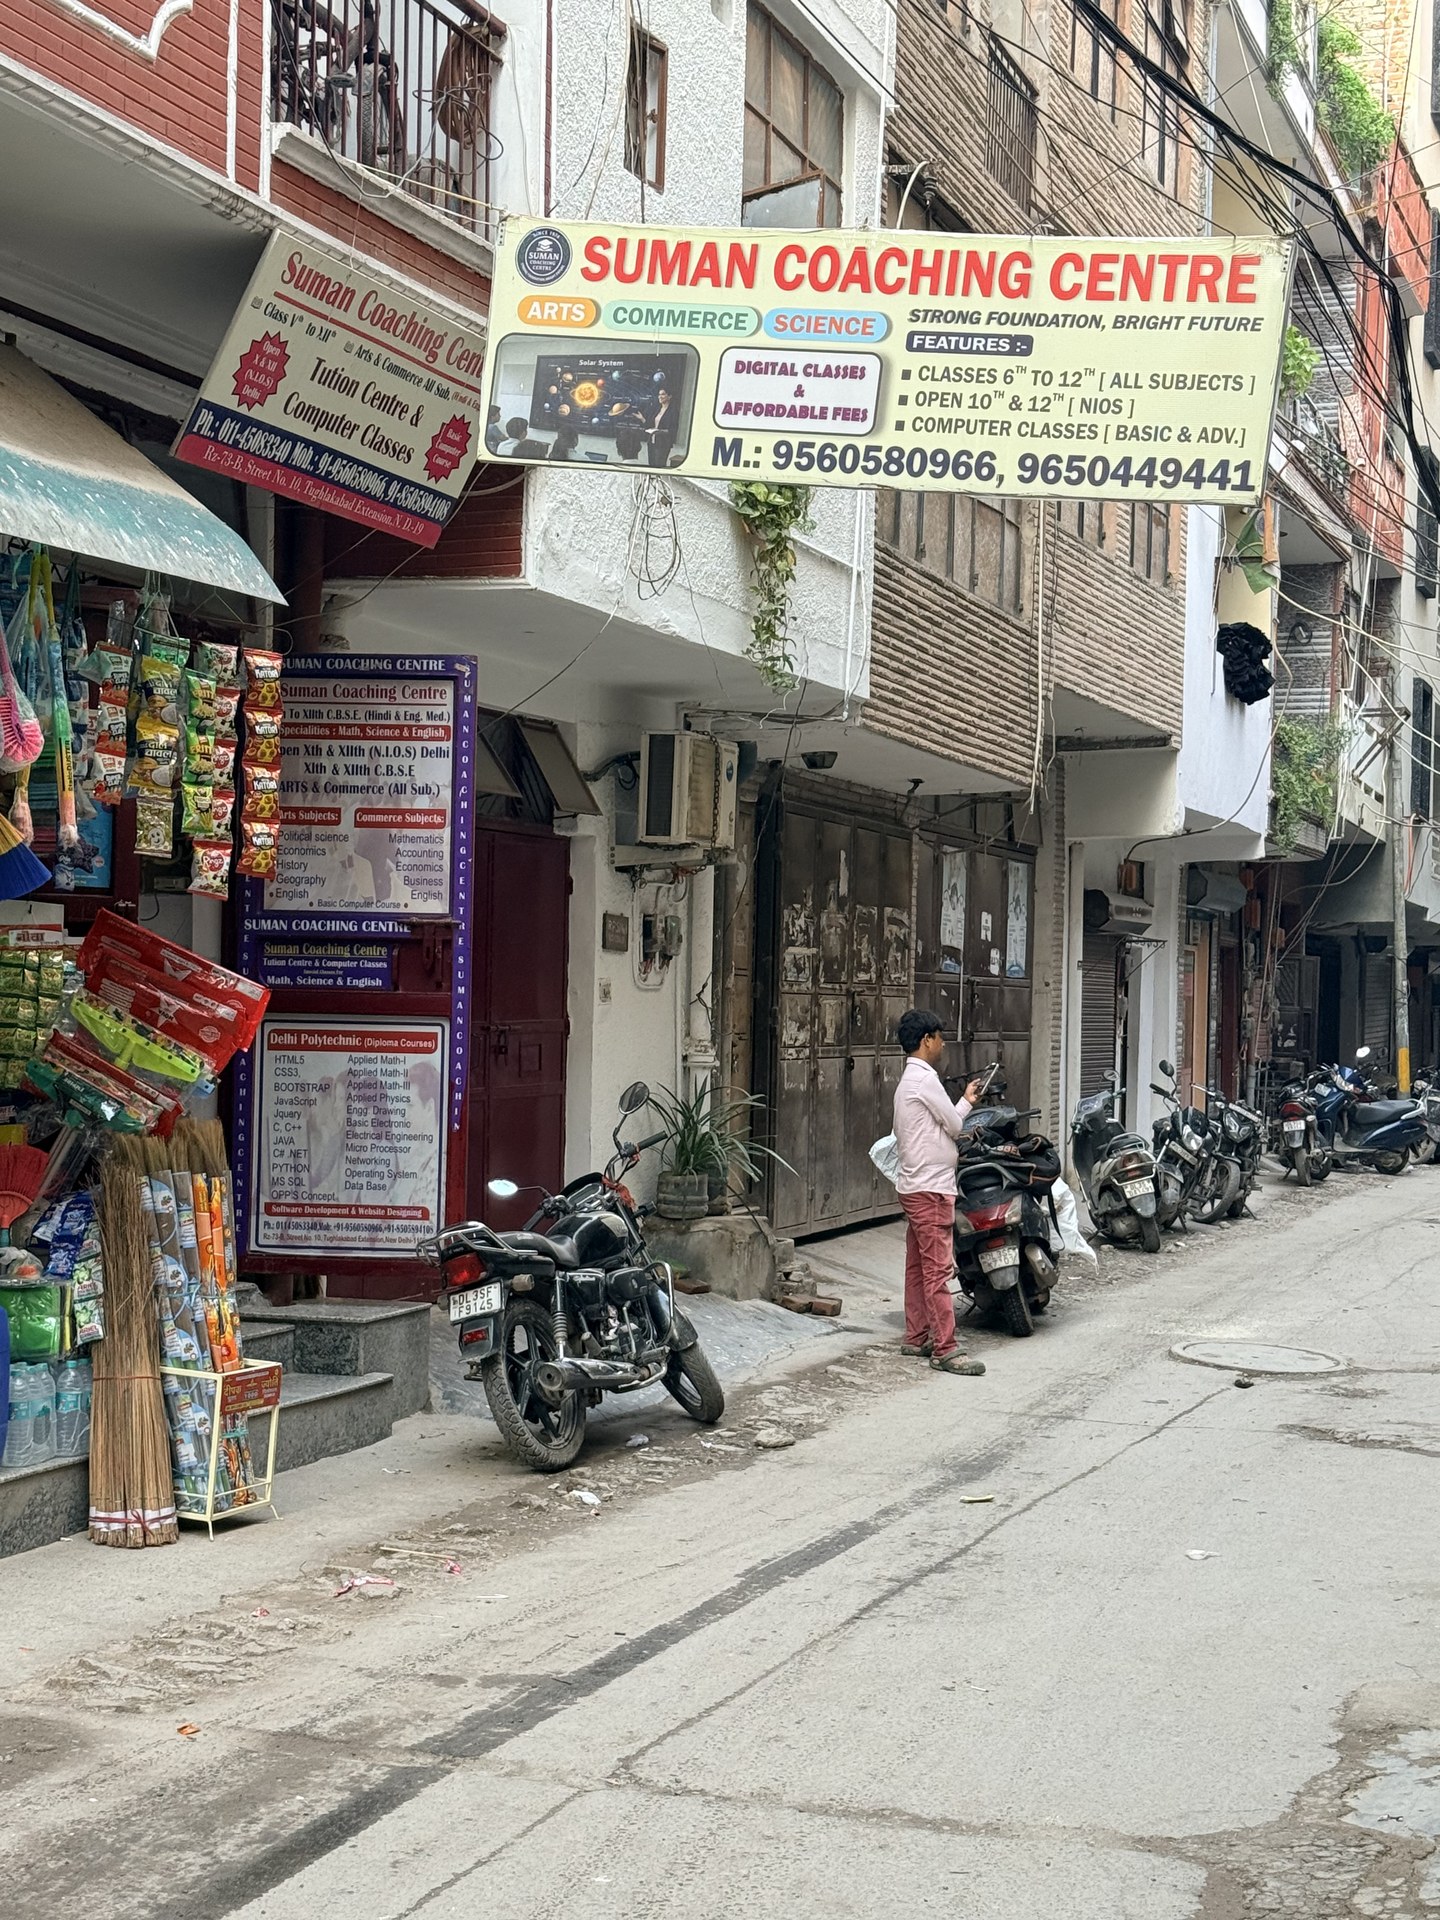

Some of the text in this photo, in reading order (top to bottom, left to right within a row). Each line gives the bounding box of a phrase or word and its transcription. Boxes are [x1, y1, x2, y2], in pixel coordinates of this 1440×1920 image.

[528, 251, 560, 261] SUMAN
[580, 236, 1261, 303] SUMAN COACHING CENTRE
[264, 301, 289, 324] Class
[281, 251, 448, 364] Suman Coaching
[527, 301, 877, 336] ARTS COMMERCE SCIENCE
[908, 308, 1264, 332] STRONG FOUNDATION, BRIGHT FUTURE
[262, 341, 281, 357] Open
[912, 335, 1010, 351] FEATURES
[354, 344, 424, 388] Arts Commerce
[597, 359, 624, 367] System
[734, 360, 866, 380] DIGITAL CLASSES
[918, 365, 1244, 392] CLASSES TO SUBJECTS
[242, 385, 263, 400] Delhi
[309, 356, 424, 428] Tution Centre &
[793, 383, 805, 398] &
[915, 391, 1023, 411] OPEN &
[721, 401, 868, 423] AFFORDABLE FEES
[283, 391, 415, 464] Computer Classes
[911, 416, 1192, 443] COMPUTER CLASSES BASIC &
[218, 417, 451, 521] 011-45083340 91-8505894108
[772, 440, 1256, 492] 9560580966, 9650449441
[245, 459, 356, 510] Street No. Tughlakabad
[282, 658, 446, 671] SUMAN COACHING CENTRE
[281, 682, 447, 702] Suman Coaching Centre
[289, 709, 300, 719] To
[302, 709, 324, 720] XIIth
[326, 710, 362, 721] C.B.S.E.
[364, 710, 391, 723] (Hindi
[403, 711, 423, 723] Eng.
[425, 711, 450, 723] Med.)
[280, 724, 401, 738] Specialities Math, Science
[303, 744, 450, 760] Xth & XIIth (N.I.O.S) Delhi
[304, 762, 416, 777] XIth & XIIth C.B.S.E
[279, 781, 441, 797] ARTS & Commerce (All Sub.)
[300, 810, 338, 822] Subjects:
[356, 811, 445, 825] Commerce Subjects:
[278, 830, 349, 843] Political science
[389, 833, 444, 844] Mathematics
[277, 845, 327, 856] Economics
[395, 848, 444, 860] Accounting
[276, 859, 308, 872] History
[395, 862, 444, 872] Economics
[276, 873, 326, 887] Geography
[403, 875, 443, 887] Business
[275, 888, 309, 901] English
[411, 889, 443, 902] English
[317, 898, 401, 910] Basic Computer Course
[244, 919, 358, 932] SUMAN COACHING
[263, 942, 387, 957] Suman Coaching Centre
[263, 958, 387, 969] Tution Centre Computer Classes
[266, 976, 382, 988] Math, Science English
[270, 1032, 436, 1050] Delhi Polytechnic (Diploma Courses)
[274, 1055, 305, 1064] HTML5
[347, 1055, 406, 1065] Applied Math-I
[347, 1067, 408, 1078] Applied Math-II
[274, 1083, 330, 1093] BOOTSTRAP
[347, 1080, 411, 1090] Applied Math-III
[274, 1097, 317, 1107] JavaScript
[346, 1093, 411, 1104] Applied Physics
[273, 1109, 301, 1120] Jquery
[373, 1106, 406, 1117] Drawing
[346, 1118, 411, 1129] Basic Electronic
[273, 1136, 295, 1146] JAVA
[346, 1131, 433, 1144] Electrical Engineering
[346, 1143, 411, 1154] Micro Processor
[272, 1163, 310, 1173] PYTHON
[345, 1156, 390, 1167] Networking
[344, 1168, 417, 1180] Operating System
[287, 1177, 306, 1187] SQL
[344, 1181, 387, 1192] Data Base
[272, 1204, 422, 1219] Software Development Website Designing
[458, 1298, 493, 1318] F9145
